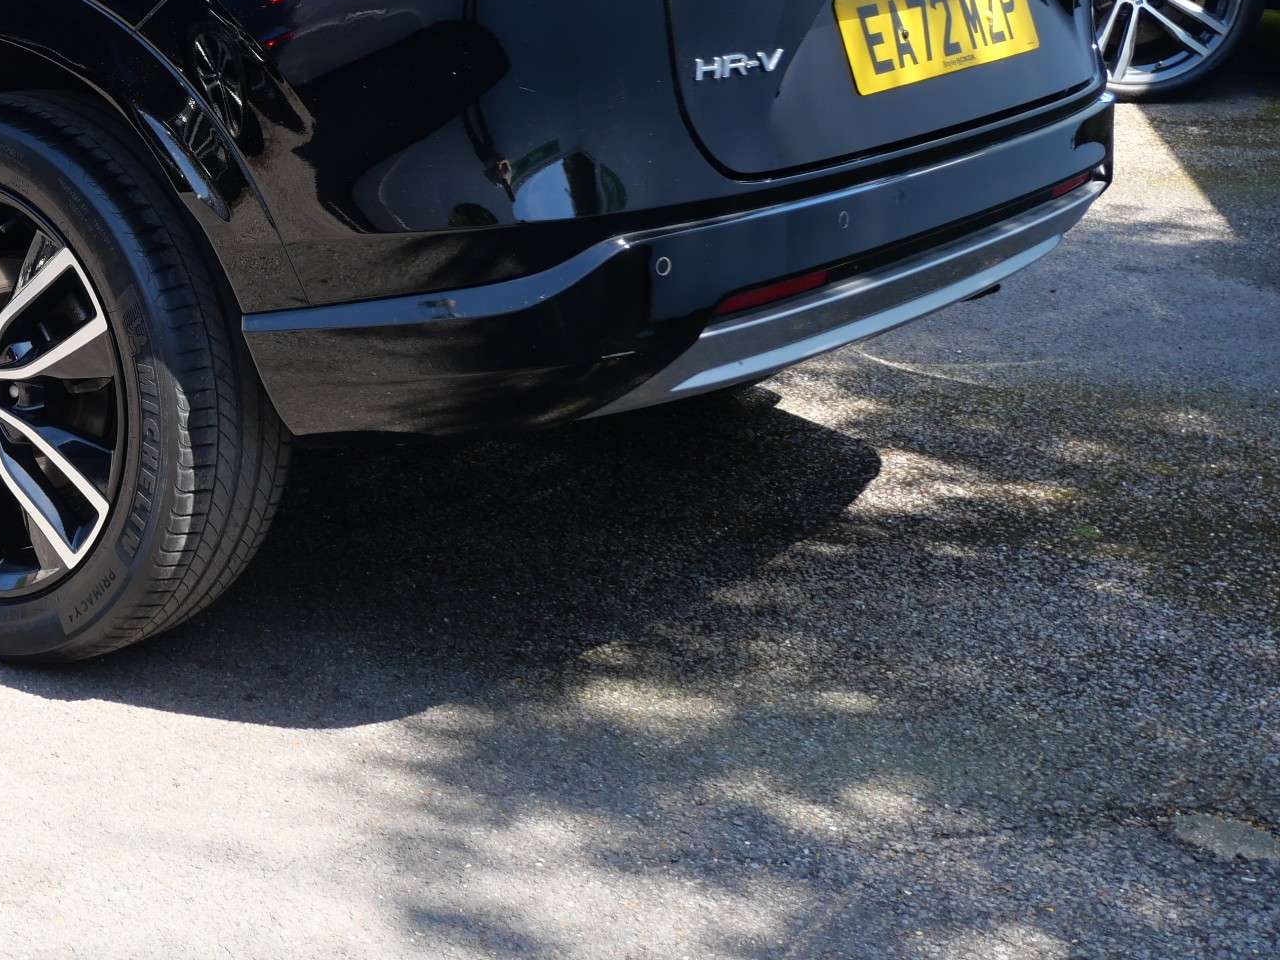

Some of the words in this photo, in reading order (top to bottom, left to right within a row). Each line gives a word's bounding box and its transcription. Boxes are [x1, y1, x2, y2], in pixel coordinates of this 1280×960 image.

[694, 48, 784, 81] HR-V
[122, 361, 161, 559] MICHELIN
[72, 567, 117, 620] PRIMACY
